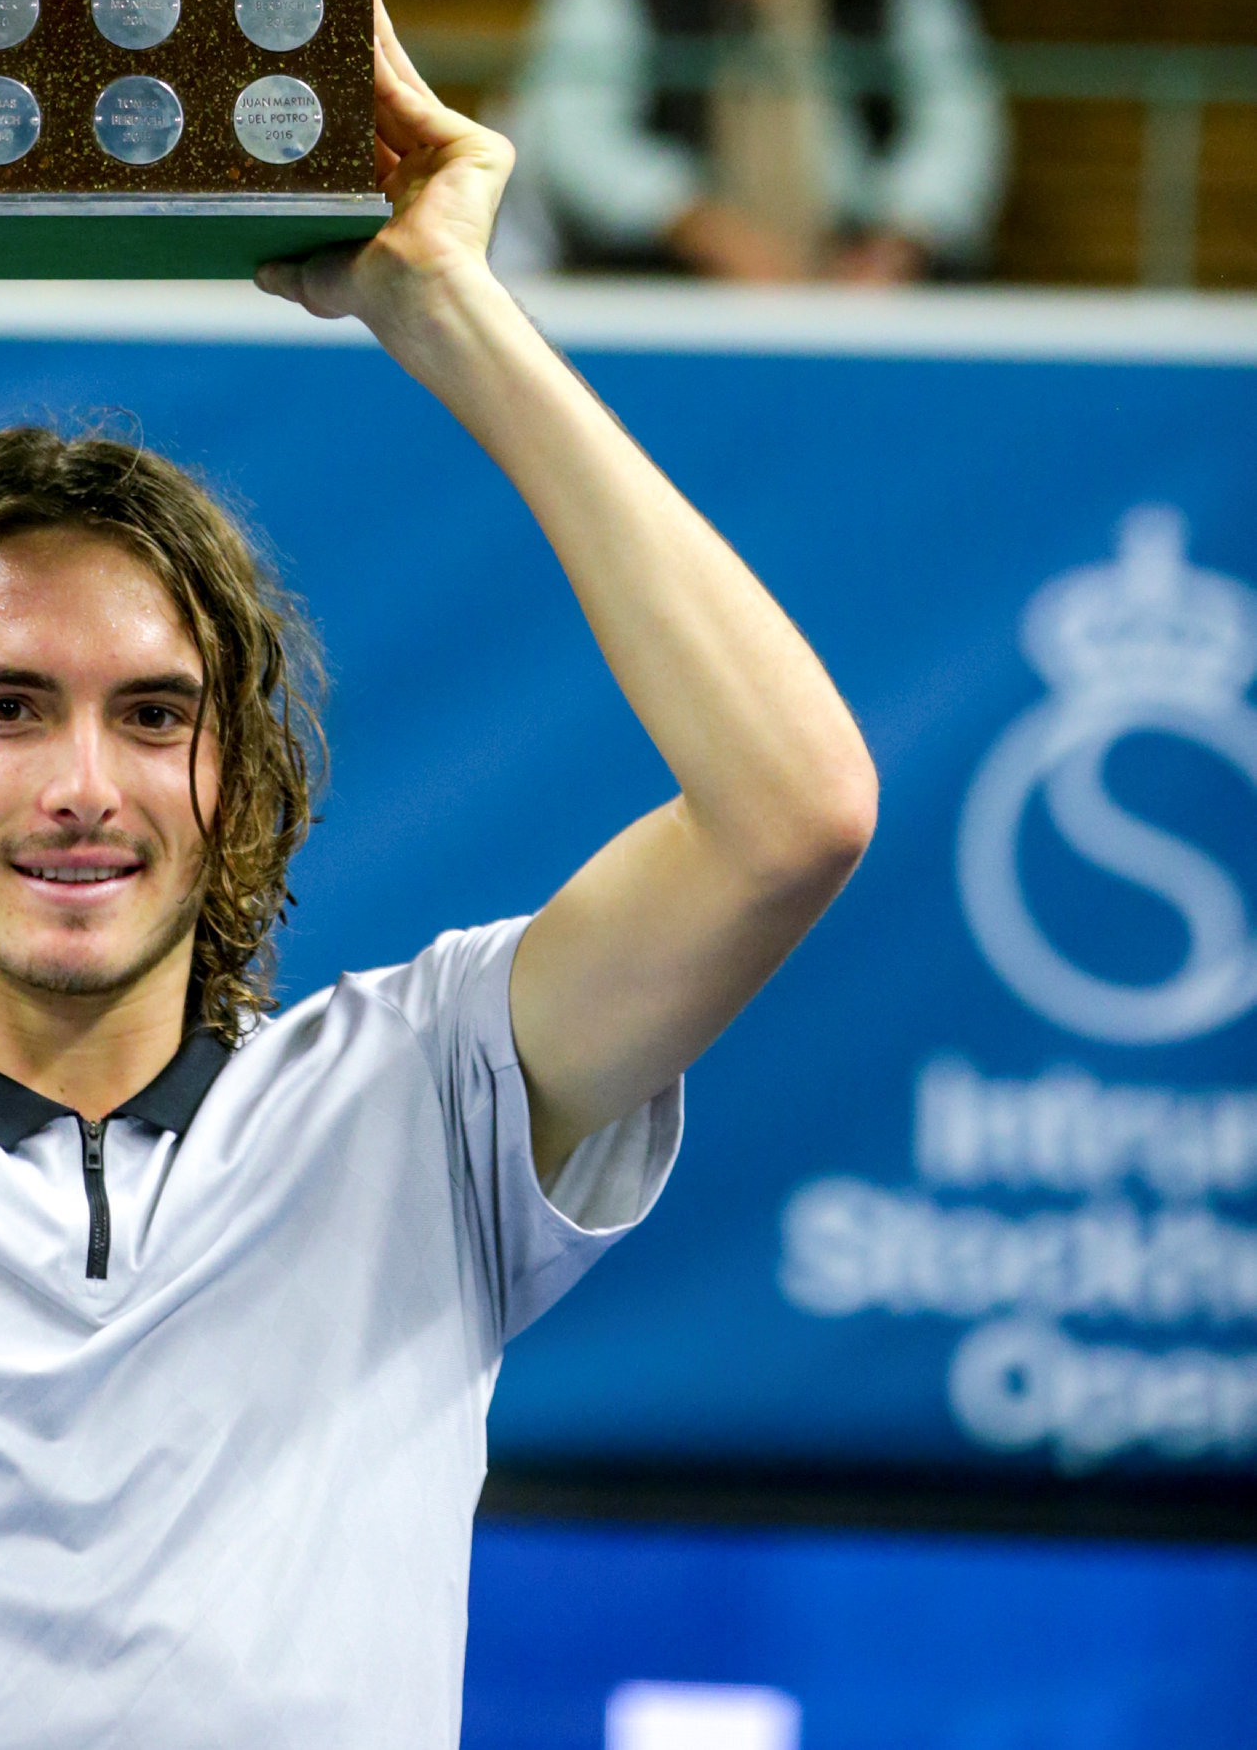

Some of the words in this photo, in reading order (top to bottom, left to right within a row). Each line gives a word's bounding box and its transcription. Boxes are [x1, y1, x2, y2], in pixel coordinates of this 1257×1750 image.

[241, 97, 271, 108] JUAN
[273, 96, 316, 107] MARTIN
[248, 114, 267, 124] DEL
[270, 113, 309, 124] POTRO
[265, 130, 294, 140] 2016
[914, 1050, 1257, 1195] Intru
